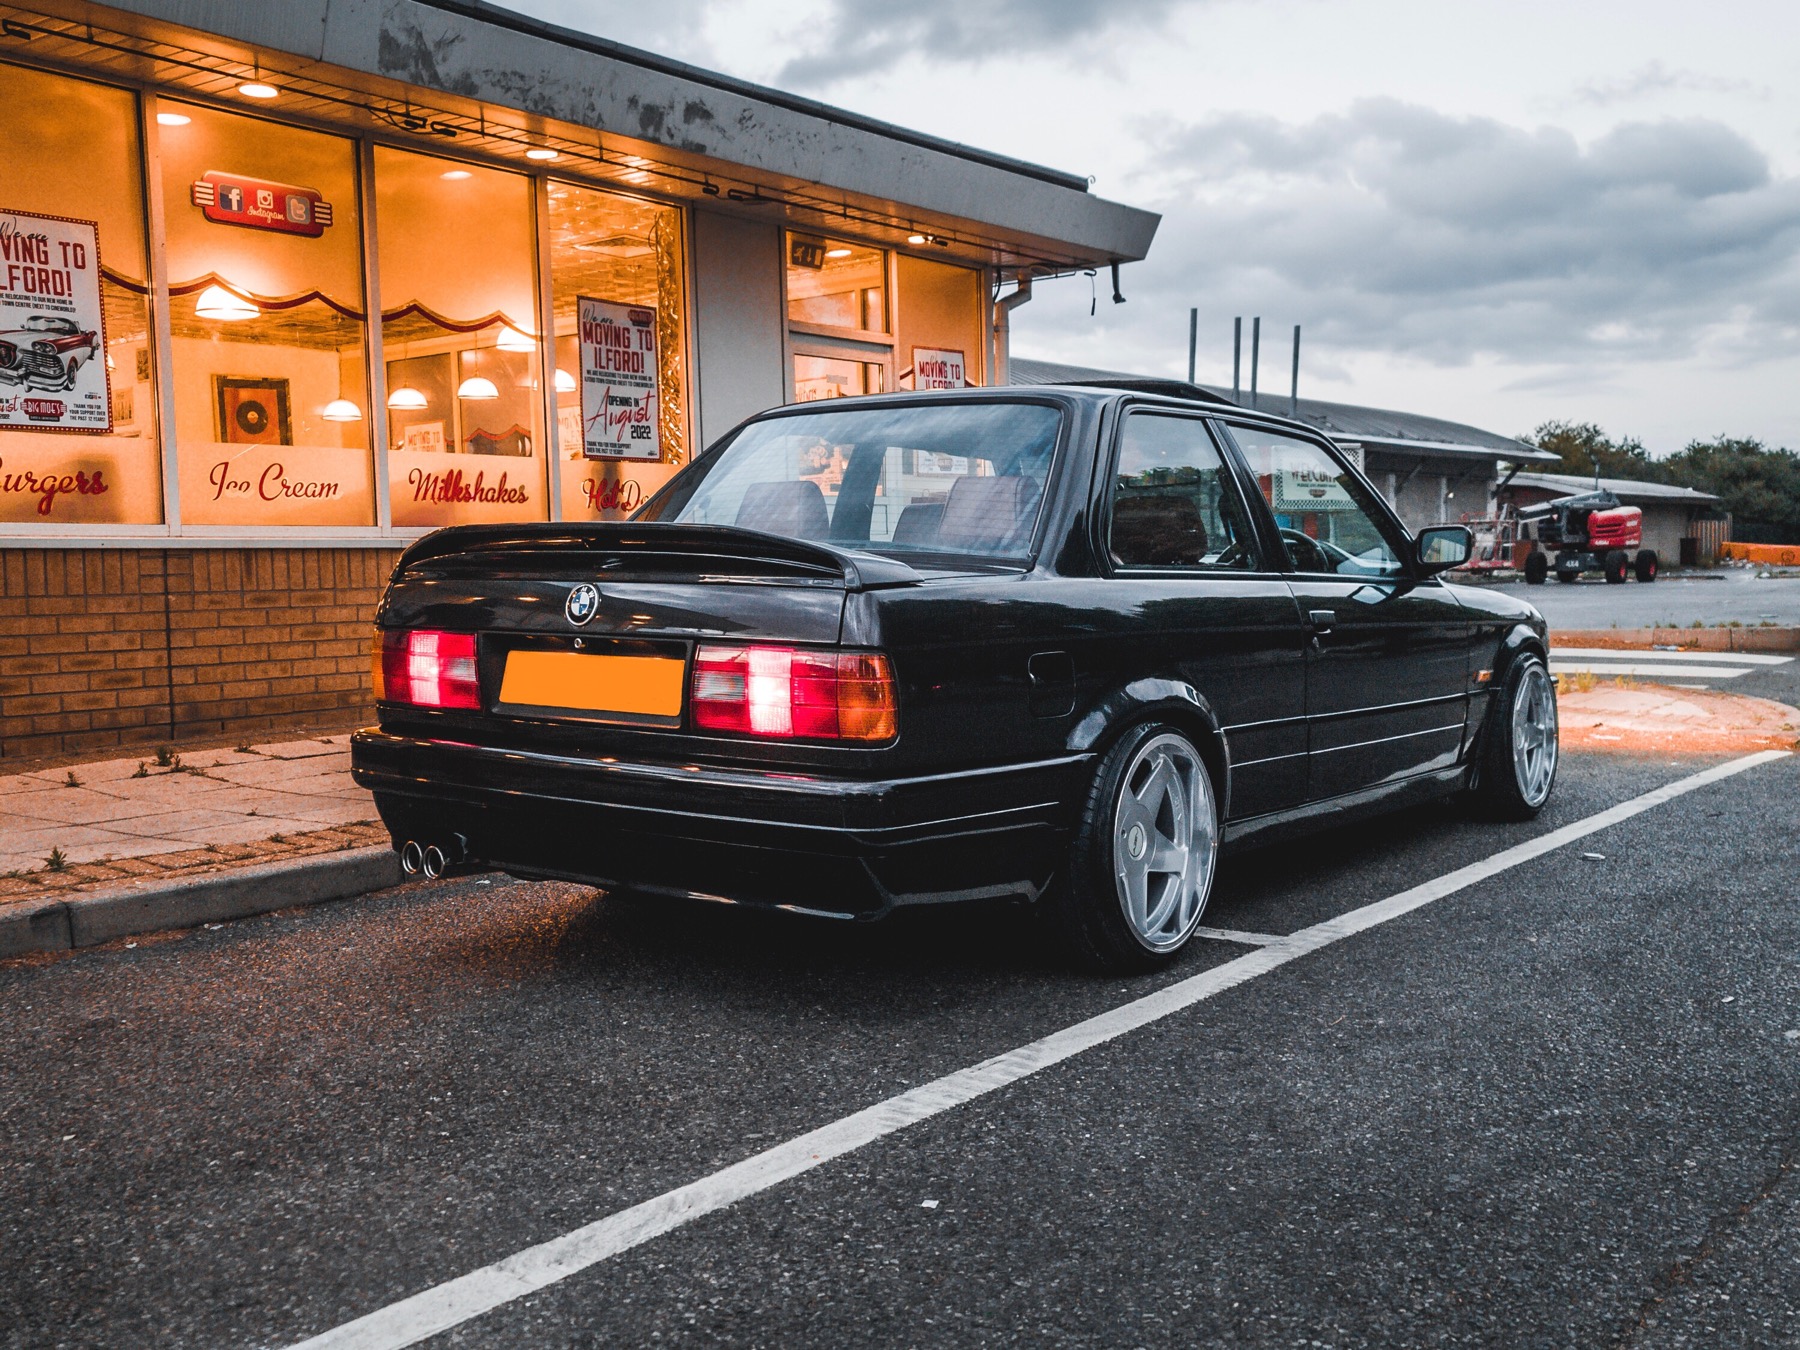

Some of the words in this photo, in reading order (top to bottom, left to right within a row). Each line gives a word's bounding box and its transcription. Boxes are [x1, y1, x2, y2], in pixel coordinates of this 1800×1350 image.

[247, 205, 284, 223] Instagram
[27, 232, 49, 241] are
[58, 241, 86, 270] TO
[0, 264, 72, 297] FORD!
[583, 303, 598, 324] We
[600, 317, 615, 325] are
[583, 321, 630, 348] MOVING
[637, 328, 653, 352] TO
[594, 346, 645, 374] ILFORD!
[919, 361, 948, 379] MOVING
[950, 364, 960, 380] TO
[28, 401, 39, 413] BIG
[586, 385, 656, 442] August
[608, 395, 632, 407] OPENING
[633, 397, 639, 407] IN
[630, 424, 651, 439] 2022
[258, 462, 339, 501] Cream
[408, 467, 529, 505] Milkshakes
[1290, 462, 1336, 483] WELCOM
[0, 468, 108, 516] urgers
[582, 477, 621, 513] Hot
